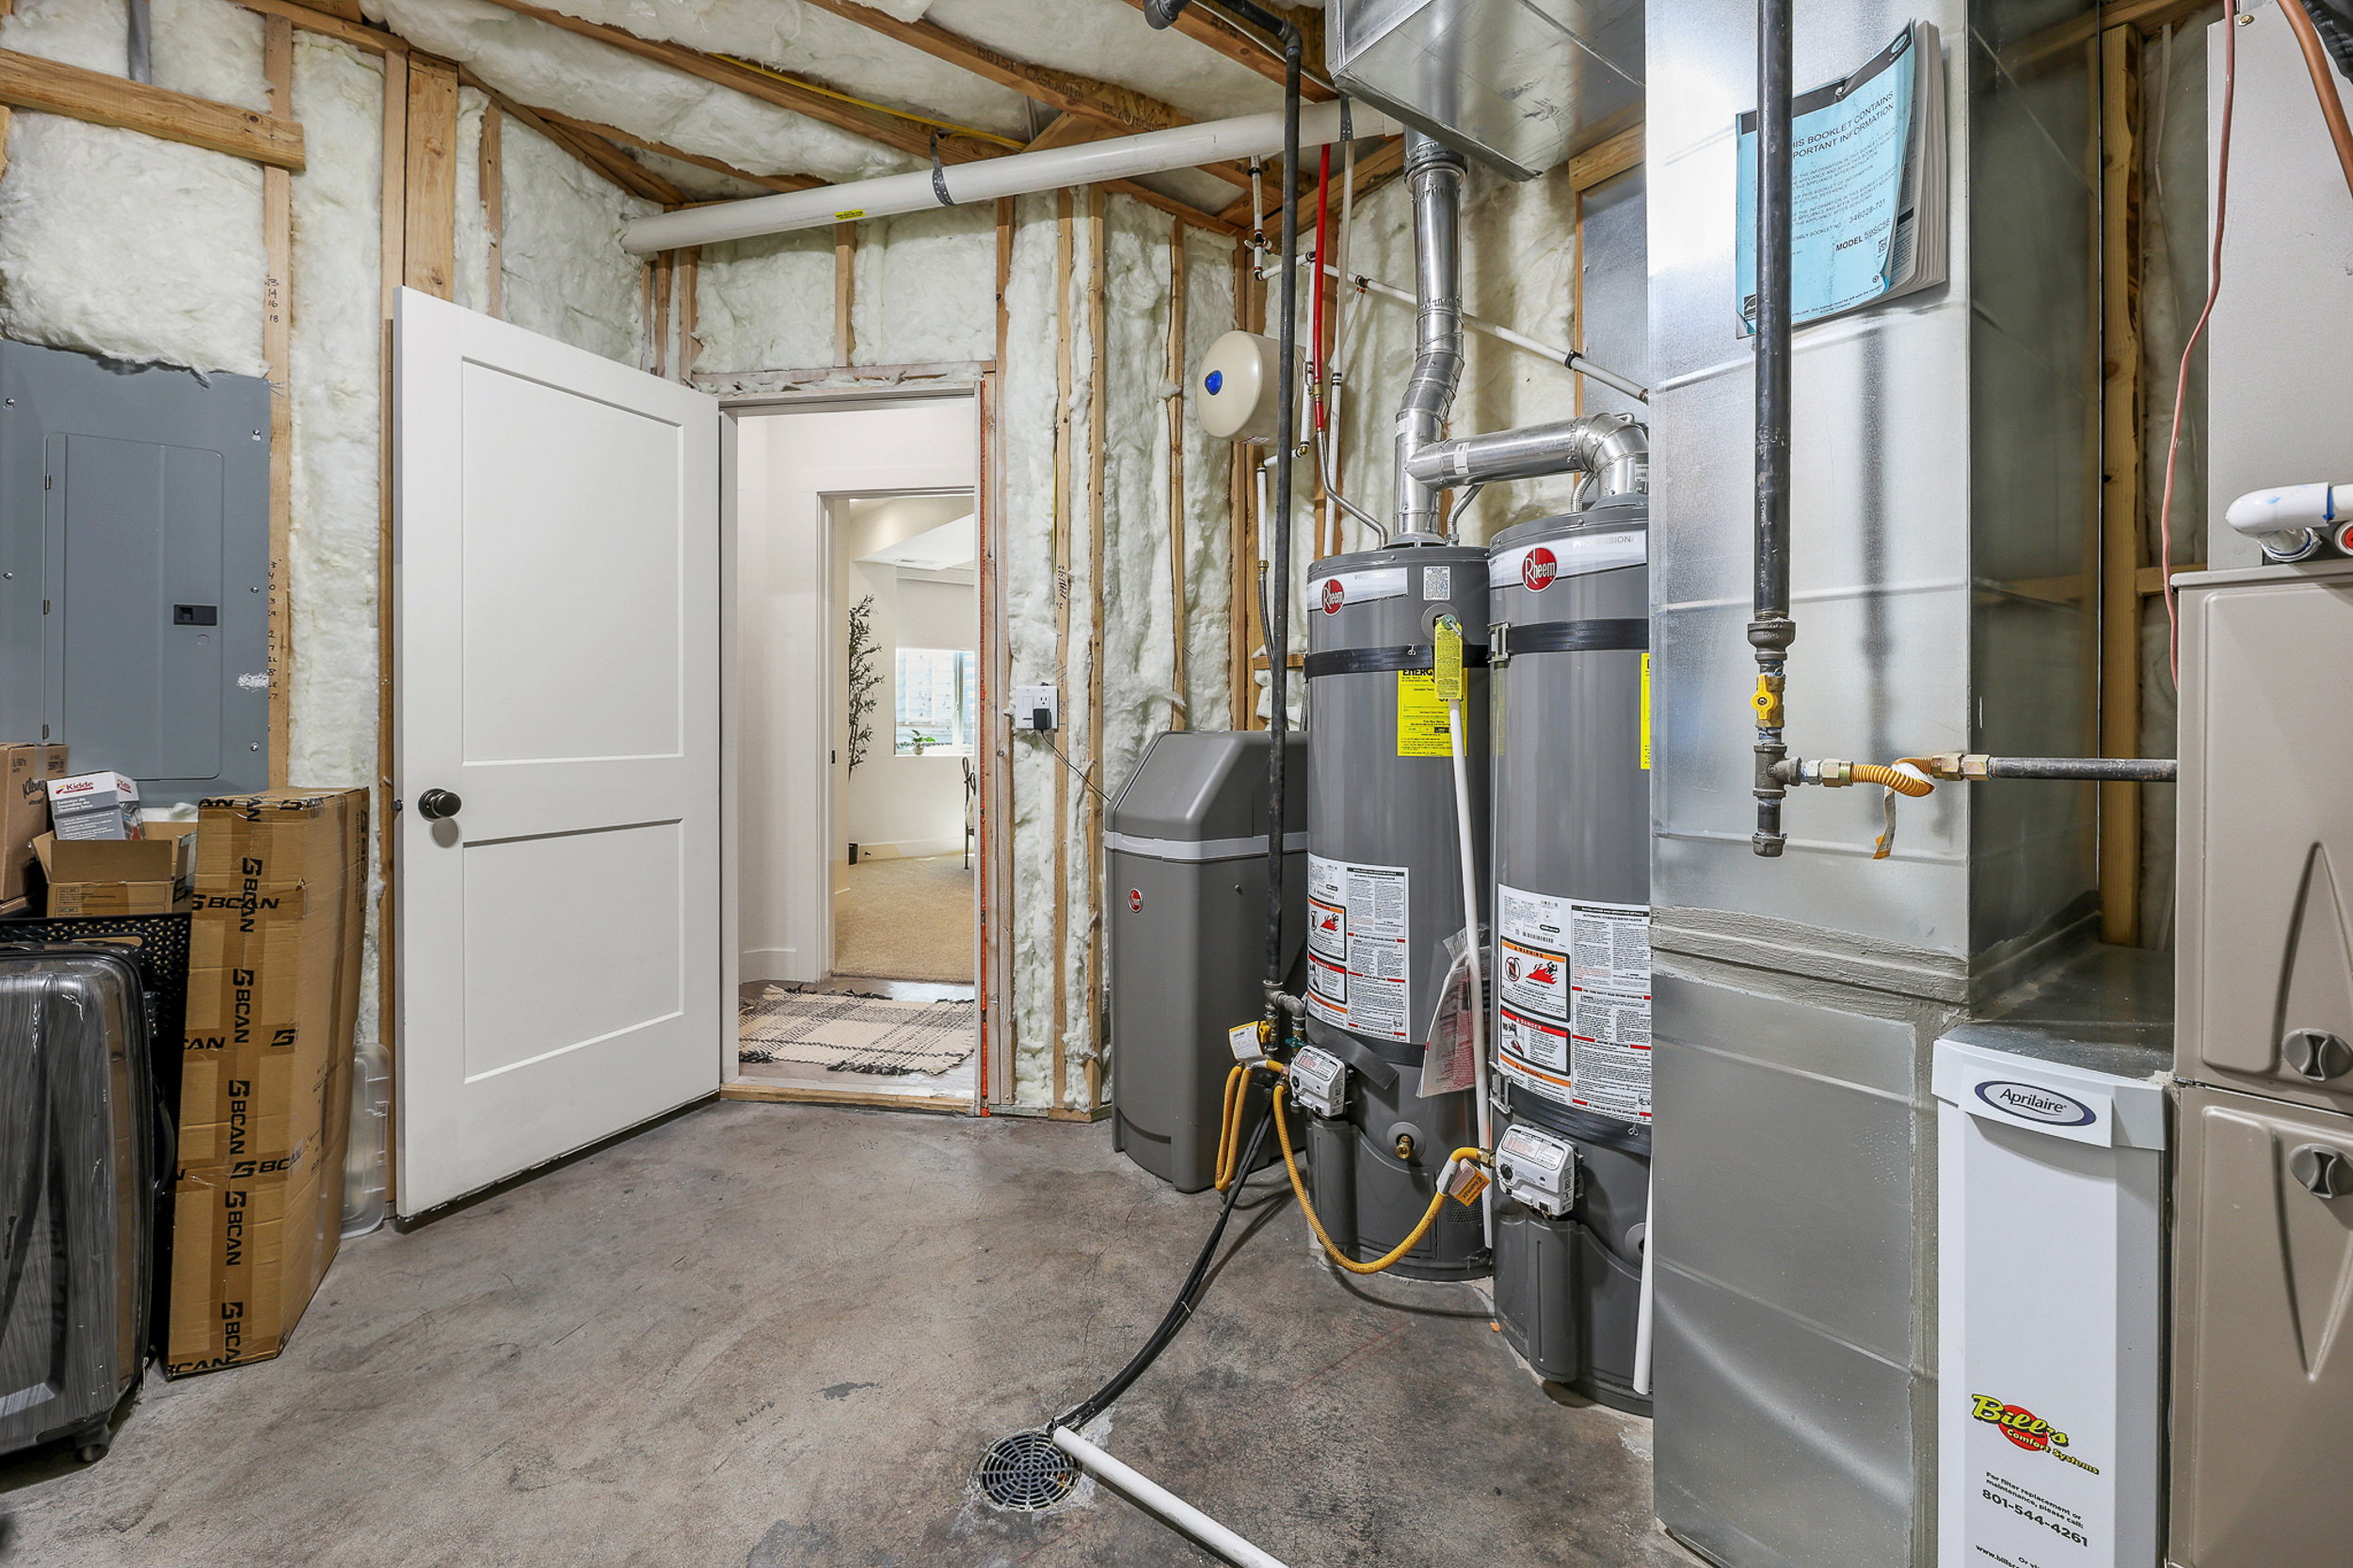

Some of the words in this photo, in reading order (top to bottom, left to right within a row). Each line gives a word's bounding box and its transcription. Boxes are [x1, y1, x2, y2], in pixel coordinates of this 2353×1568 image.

[1792, 137, 1805, 149] HIS
[1807, 120, 1852, 144] BOOKLET
[1854, 91, 1894, 124] CONTAINS
[1793, 138, 1837, 158] PORTANT
[1840, 104, 1894, 143] INFORMATION
[1835, 235, 1864, 252] MODEL
[268, 299, 279, 308] 16
[269, 313, 279, 324] 18
[1523, 549, 1558, 585] Rheem
[1322, 580, 1344, 611] Rheem
[22, 776, 47, 799] Kleene
[67, 781, 93, 790] Kidde
[207, 896, 280, 909] BCAN
[1519, 947, 1544, 958] WARNING
[234, 989, 250, 1043] BCAN
[2000, 1088, 2064, 1113] Aprilaire
[230, 1099, 246, 1154] BCAN
[226, 1210, 243, 1266] BCAN
[1972, 1394, 2069, 1448] Bill's
[2006, 1428, 2051, 1453] Comfort
[2052, 1448, 2100, 1475] Systems
[1986, 1471, 2000, 1481] For
[2001, 1479, 2020, 1490] filter
[2021, 1488, 2072, 1515] replacement
[1986, 1479, 2038, 1507] maintenance,
[2039, 1504, 2065, 1519] please
[1982, 1489, 2089, 1547] 801-544-4261
[2018, 1557, 2028, 1565] Or
